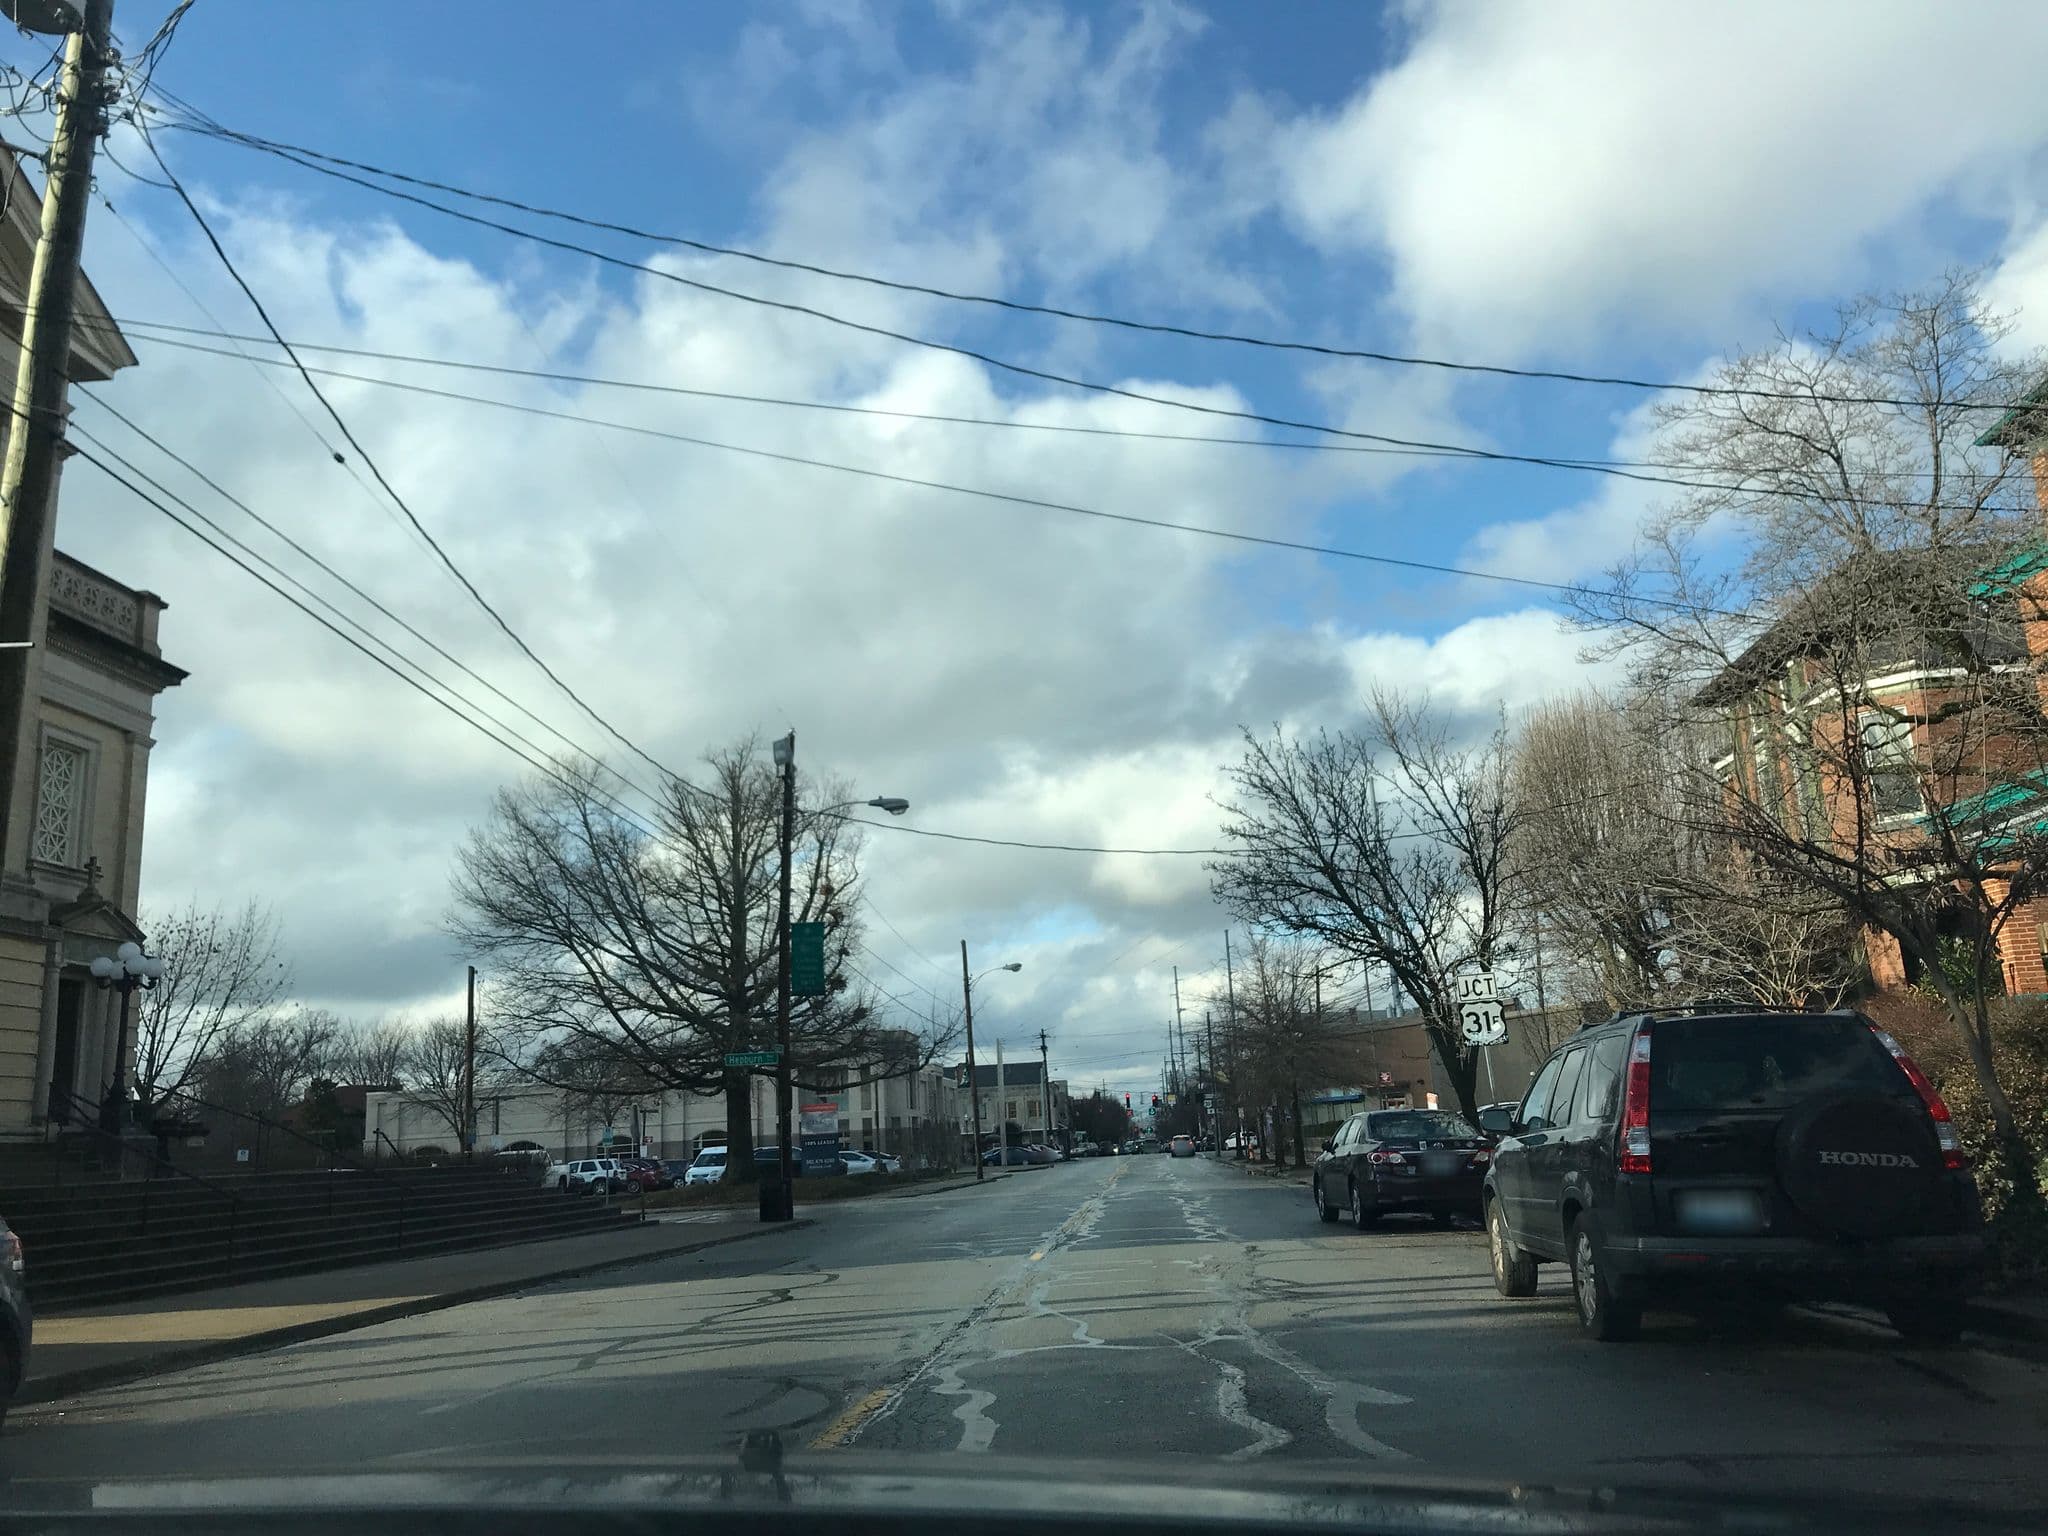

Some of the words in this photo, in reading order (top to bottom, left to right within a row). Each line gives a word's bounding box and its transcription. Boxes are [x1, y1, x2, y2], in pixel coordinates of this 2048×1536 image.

[1461, 977, 1493, 997] JCT
[729, 1055, 763, 1064] Hepburn
[1819, 1151, 1919, 1168] HONDA
